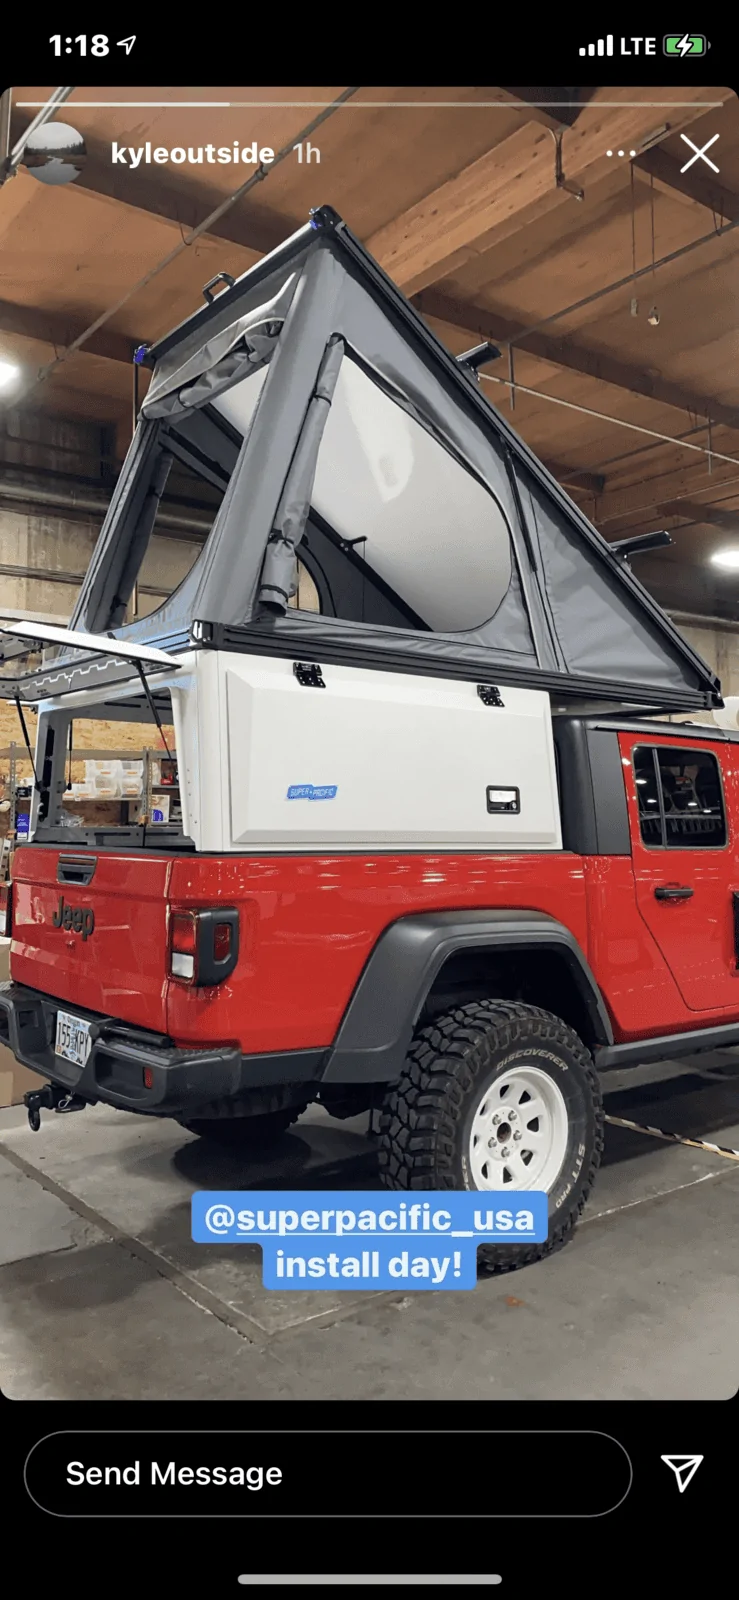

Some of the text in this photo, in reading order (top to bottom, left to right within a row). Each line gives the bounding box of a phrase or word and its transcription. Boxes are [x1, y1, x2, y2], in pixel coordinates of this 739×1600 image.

[290, 787, 310, 797] SUPER
[53, 896, 95, 942] Jeep
[58, 1022, 71, 1048] 155
[496, 1048, 569, 1071] DISCOVERER
[572, 1143, 585, 1184] STT
